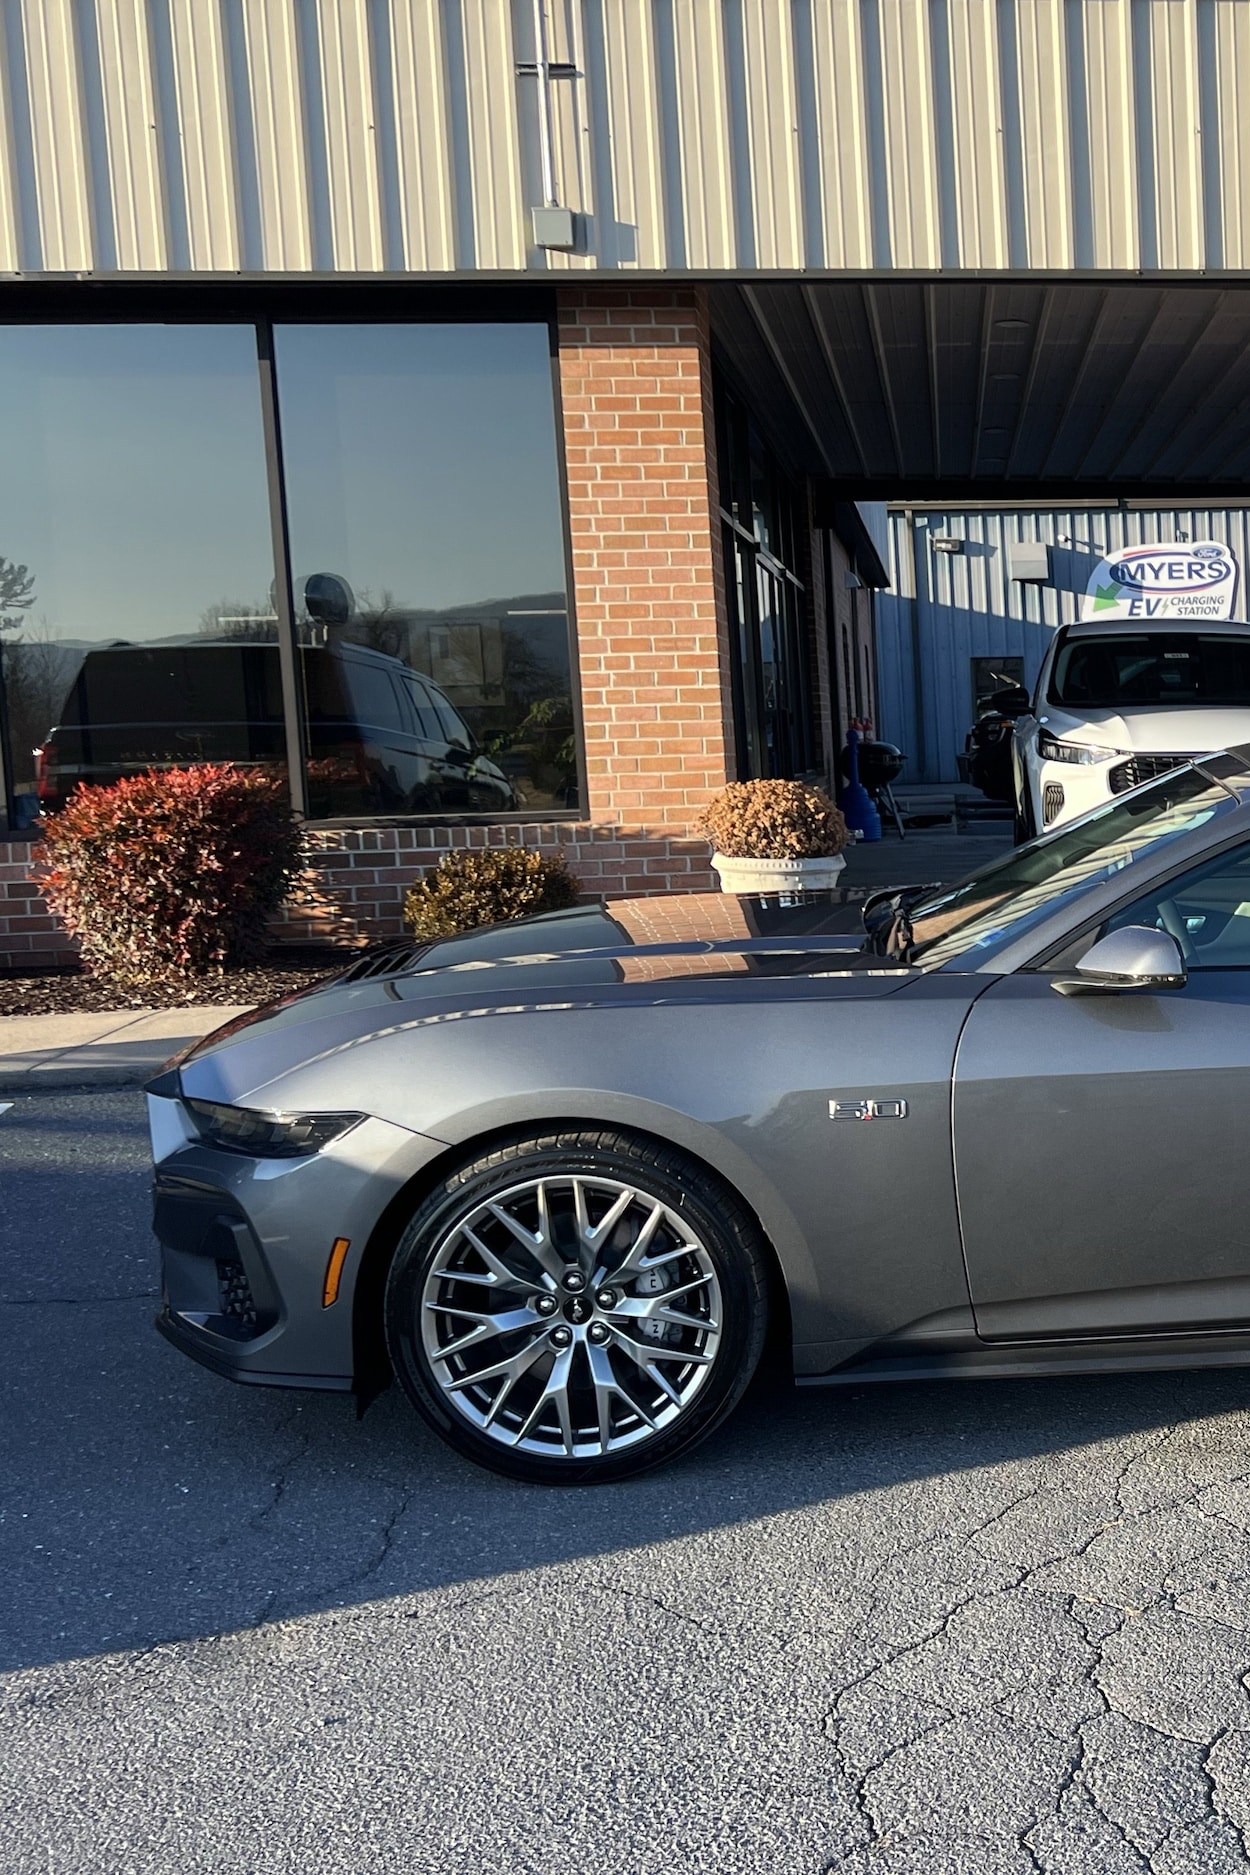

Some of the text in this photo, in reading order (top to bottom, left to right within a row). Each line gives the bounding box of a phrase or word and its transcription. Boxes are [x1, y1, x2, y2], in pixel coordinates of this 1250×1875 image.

[1197, 549, 1218, 559] Ford
[1119, 561, 1224, 581] MYERS
[1128, 598, 1162, 616] EV
[1170, 595, 1225, 606] CHARGING
[1177, 606, 1219, 615] STATION
[828, 1099, 908, 1121] 5.0
